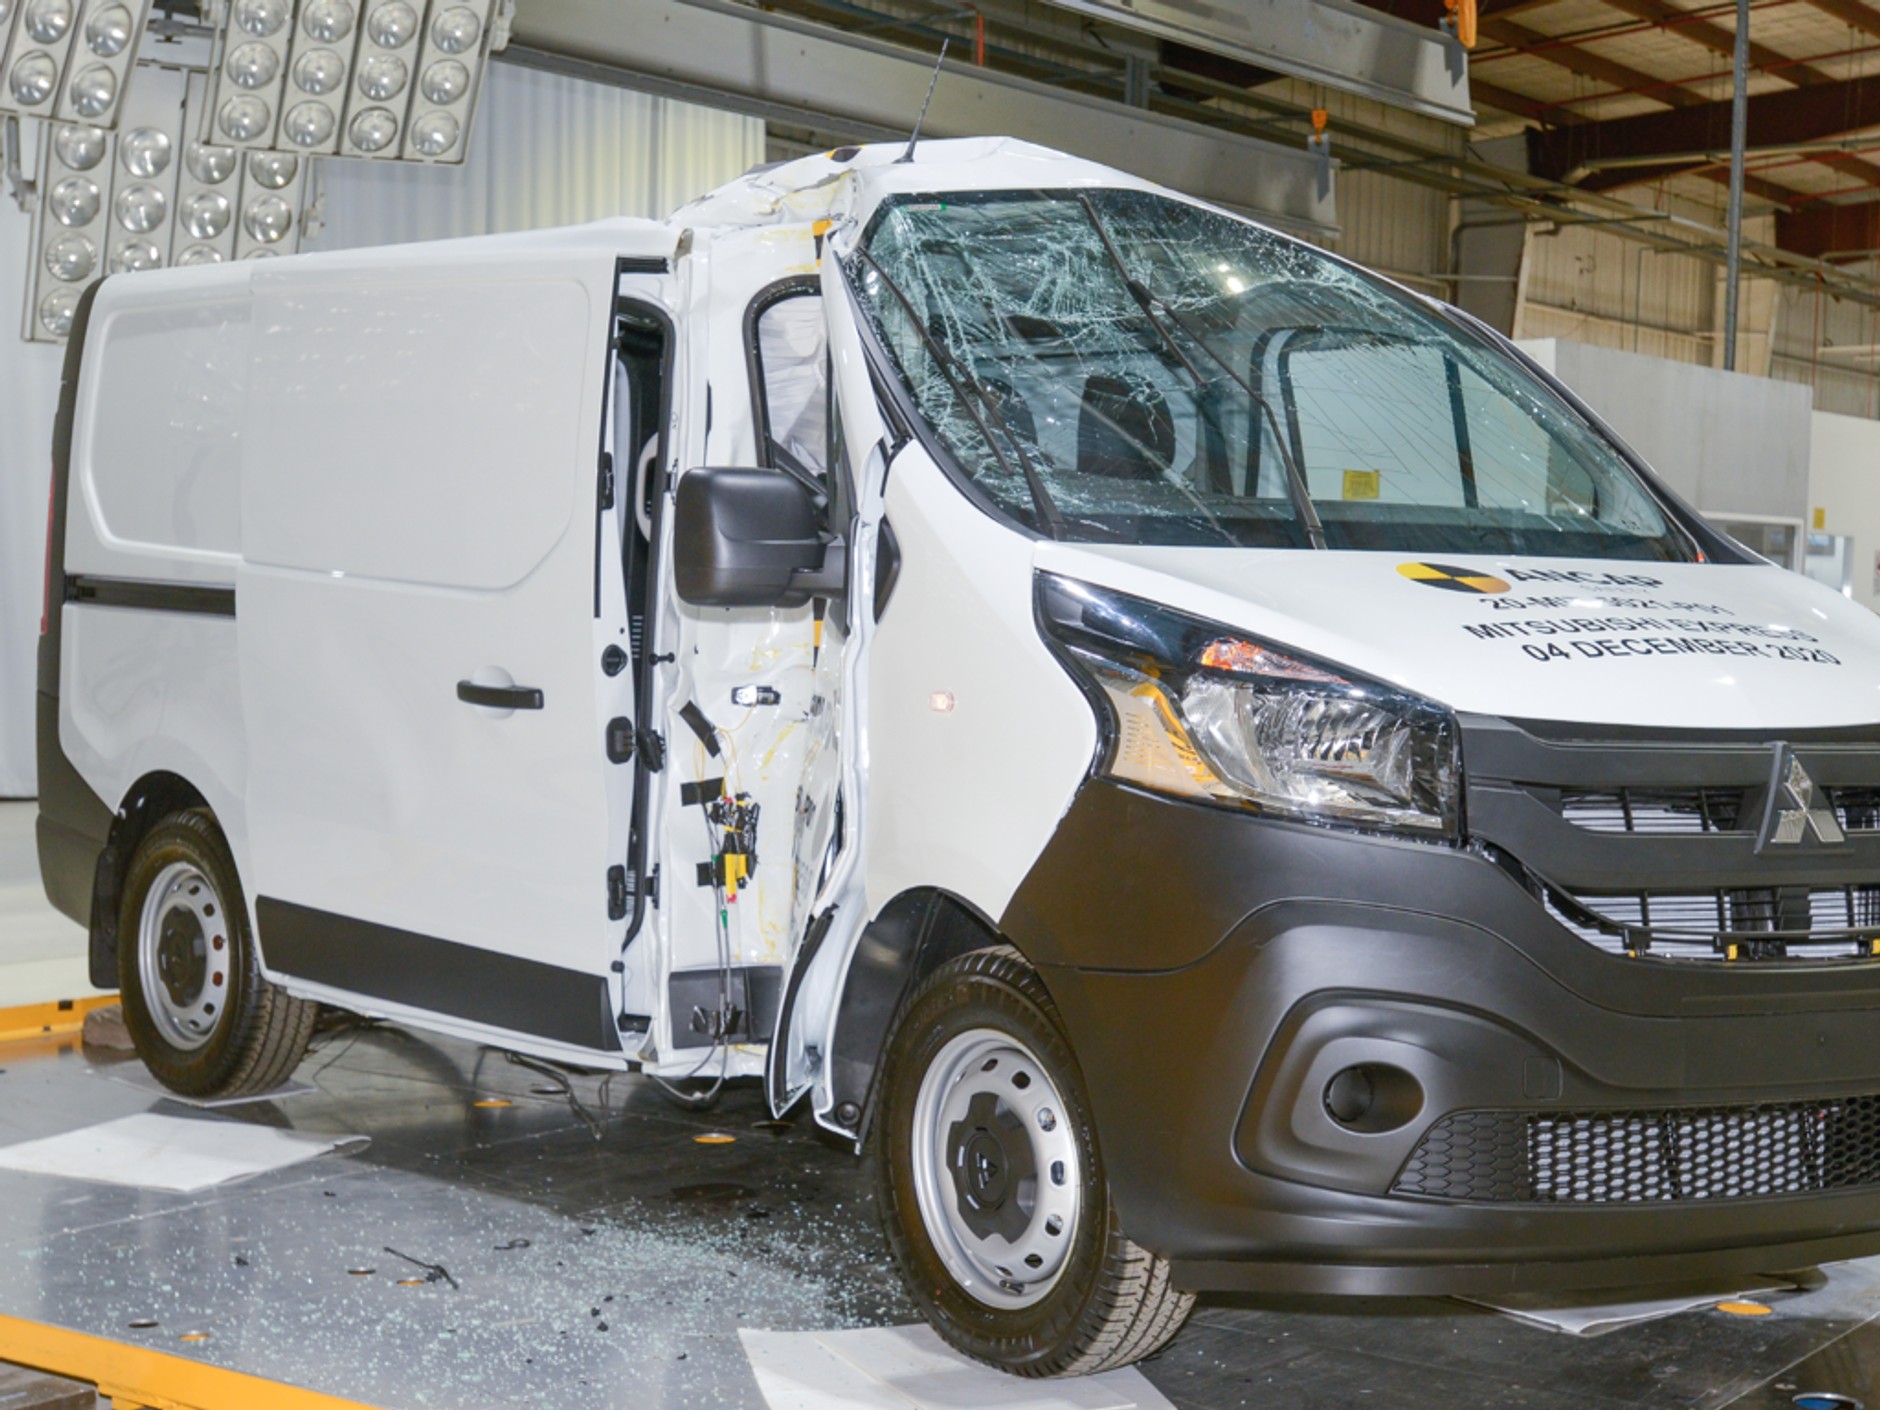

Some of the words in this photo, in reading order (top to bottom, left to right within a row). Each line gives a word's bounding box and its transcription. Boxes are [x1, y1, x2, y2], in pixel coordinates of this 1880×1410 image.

[1504, 569, 1664, 588] ANCAP
[1463, 617, 1672, 640] MITSUBISHI
[1666, 618, 1819, 643] EXPRESS
[1522, 642, 1571, 662] 04
[1569, 637, 1772, 659] DECEMBER
[1765, 644, 1842, 665] 2020
